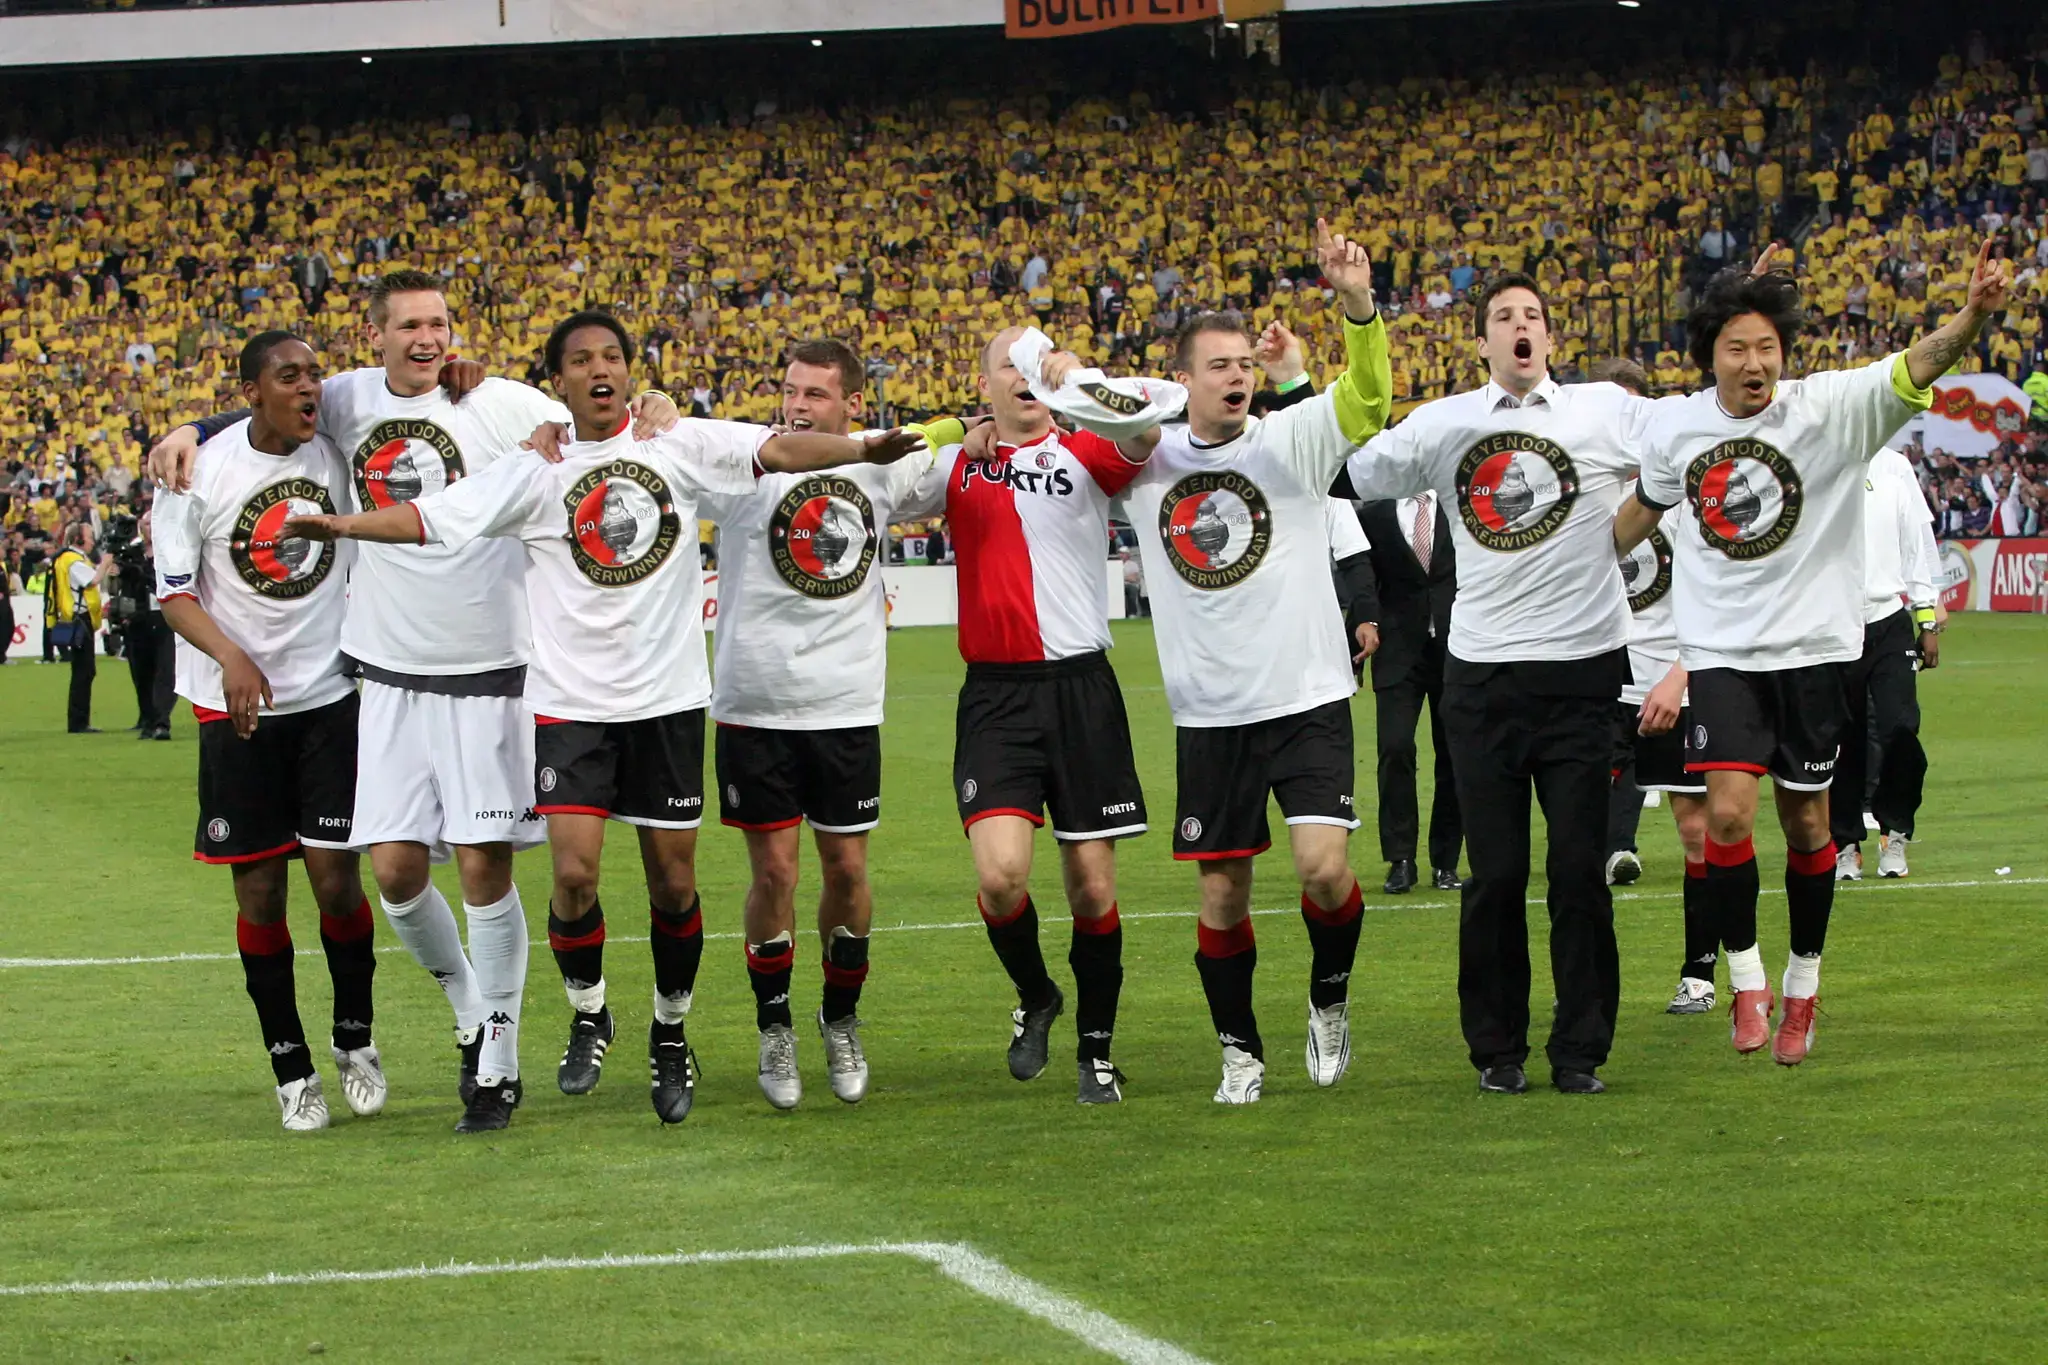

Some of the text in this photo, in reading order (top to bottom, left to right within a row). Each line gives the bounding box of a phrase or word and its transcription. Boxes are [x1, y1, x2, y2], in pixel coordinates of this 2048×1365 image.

[359, 422, 456, 460] FEYENOORD
[1462, 435, 1568, 474] FEYENOORD
[1690, 442, 1789, 487] FEYENOORD
[367, 470, 383, 481] 20
[960, 460, 1074, 497] FORTIS
[780, 481, 871, 517] FEYENOORD
[1472, 485, 1491, 497] 20
[1702, 496, 1718, 507] 20
[579, 519, 596, 536] 20
[792, 528, 811, 540] 20
[1172, 524, 1187, 536] 20
[1166, 532, 1268, 585] BEKERWINNAAR
[774, 547, 874, 595] BEKERWINNAAR
[475, 810, 514, 820] FORTIS
[1102, 801, 1136, 816] FORTIS
[490, 1025, 506, 1042] F
